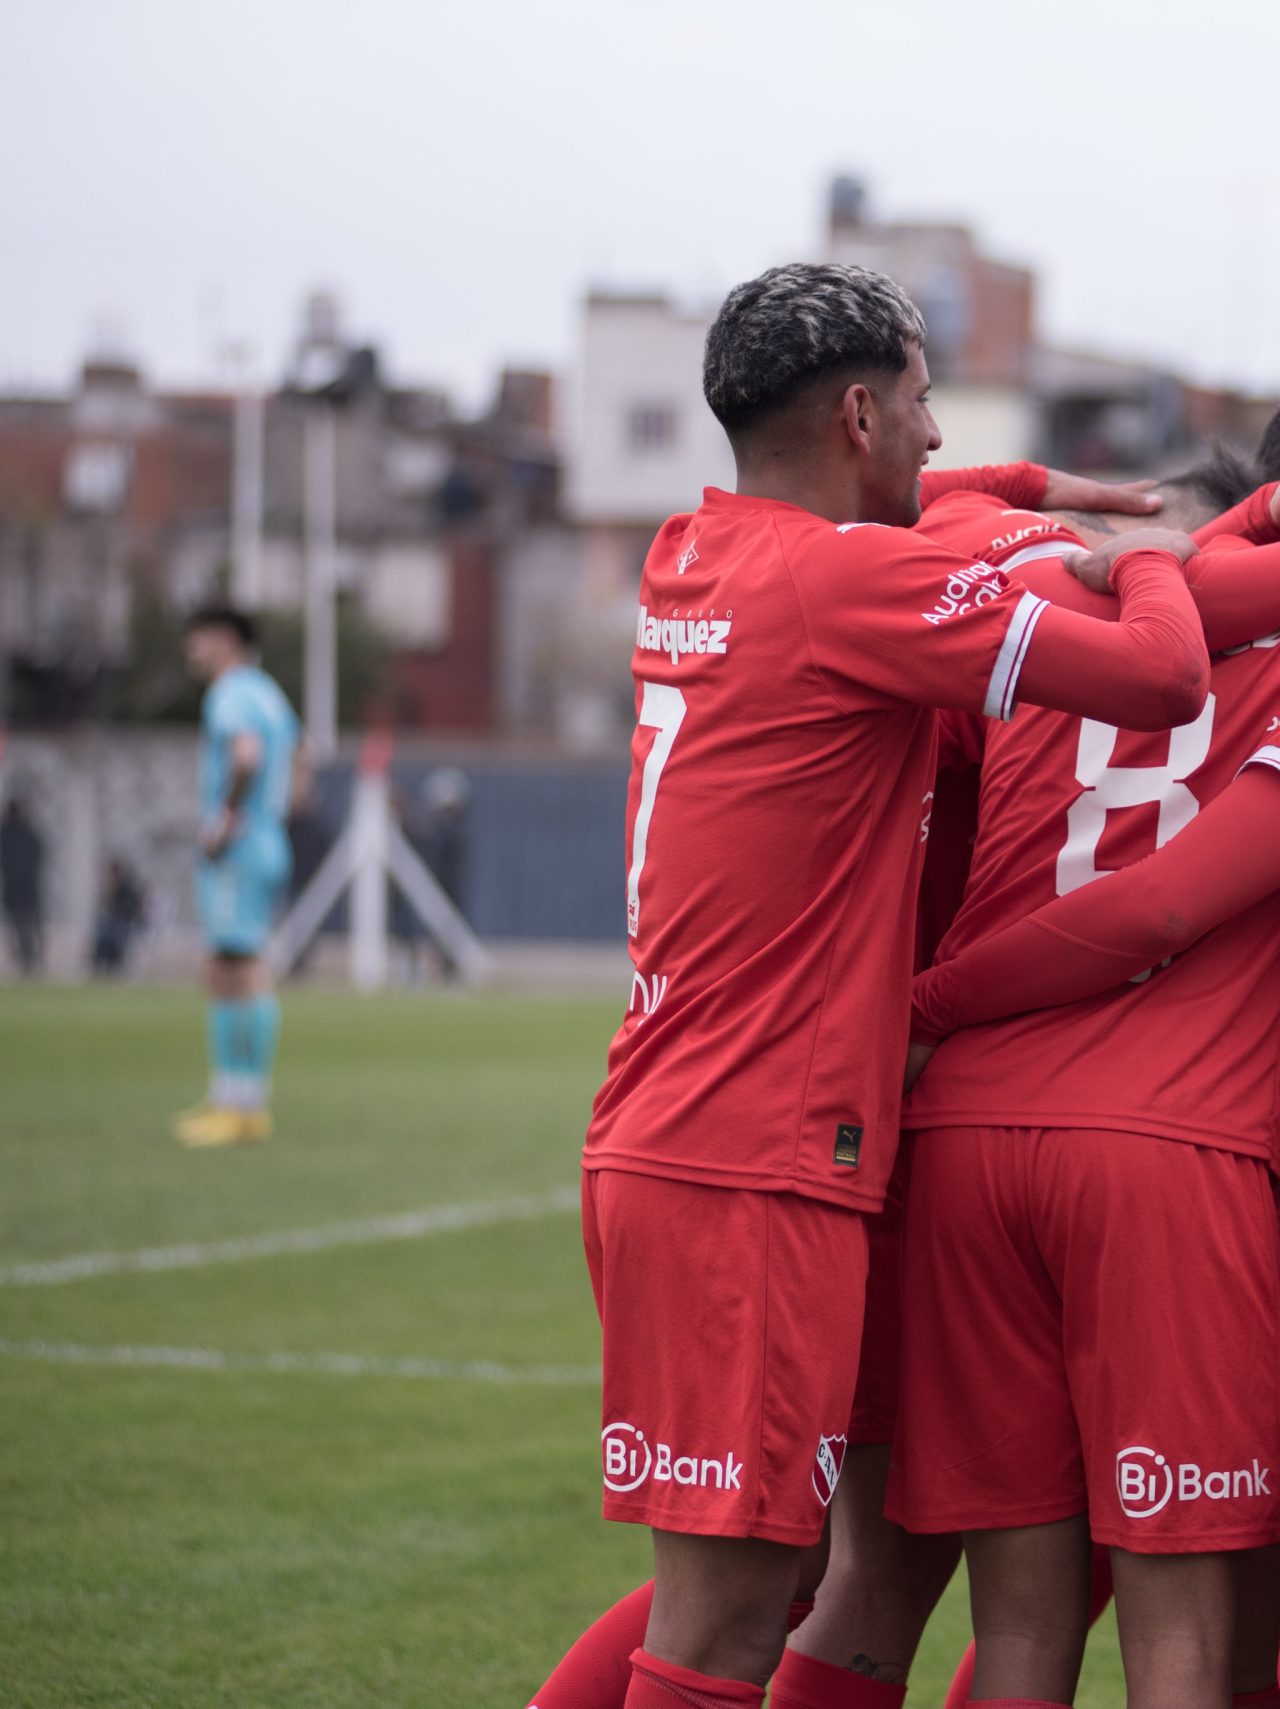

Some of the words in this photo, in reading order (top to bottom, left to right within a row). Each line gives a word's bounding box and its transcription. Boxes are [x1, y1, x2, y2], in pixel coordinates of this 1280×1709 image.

[627, 681, 688, 938] 7
[1055, 691, 1217, 897] 8
[653, 1443, 743, 1490] Bank
[1178, 1458, 1272, 1502] Bank
